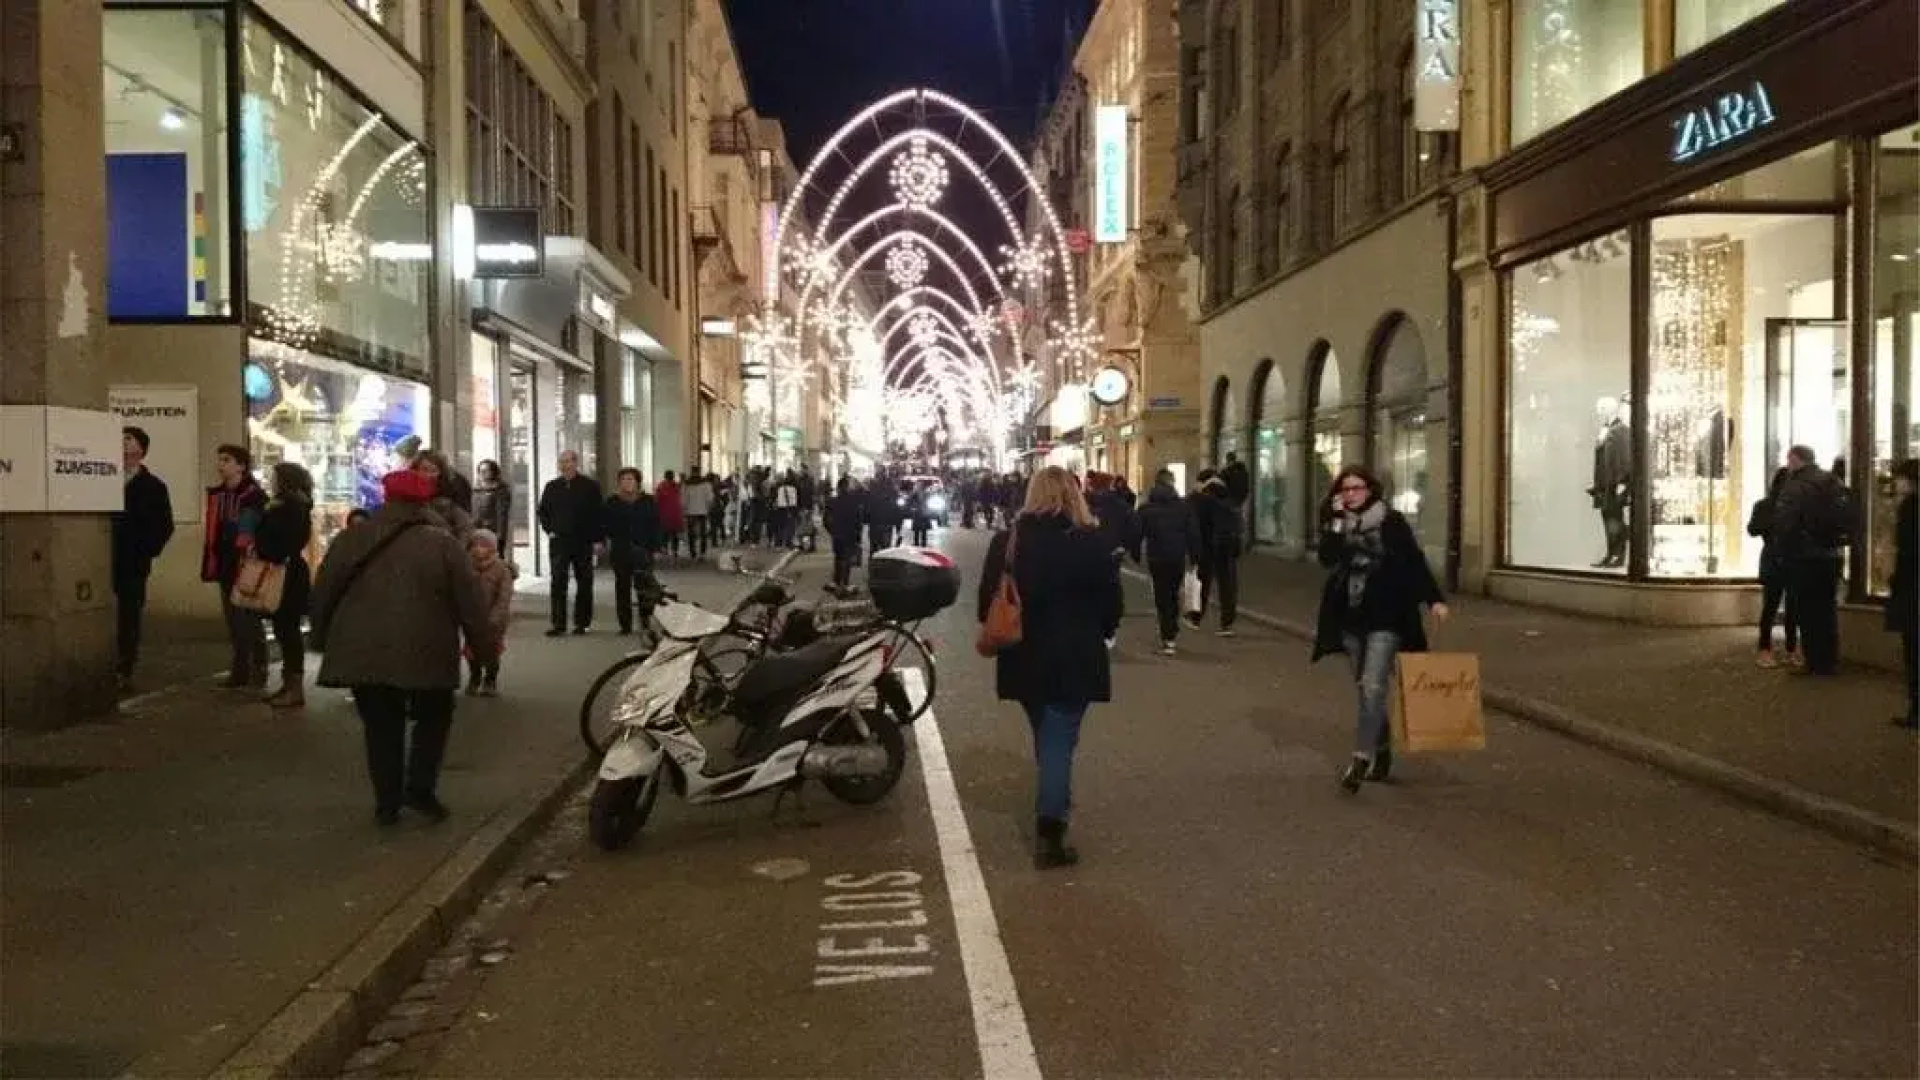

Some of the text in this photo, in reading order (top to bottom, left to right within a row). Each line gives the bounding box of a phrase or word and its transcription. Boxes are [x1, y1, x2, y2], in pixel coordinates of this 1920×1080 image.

[1671, 81, 1775, 161] ZARA
[1103, 142, 1120, 234] ROLEX
[55, 459, 117, 475] ZUMSTEIN
[813, 871, 935, 987] VELOS
